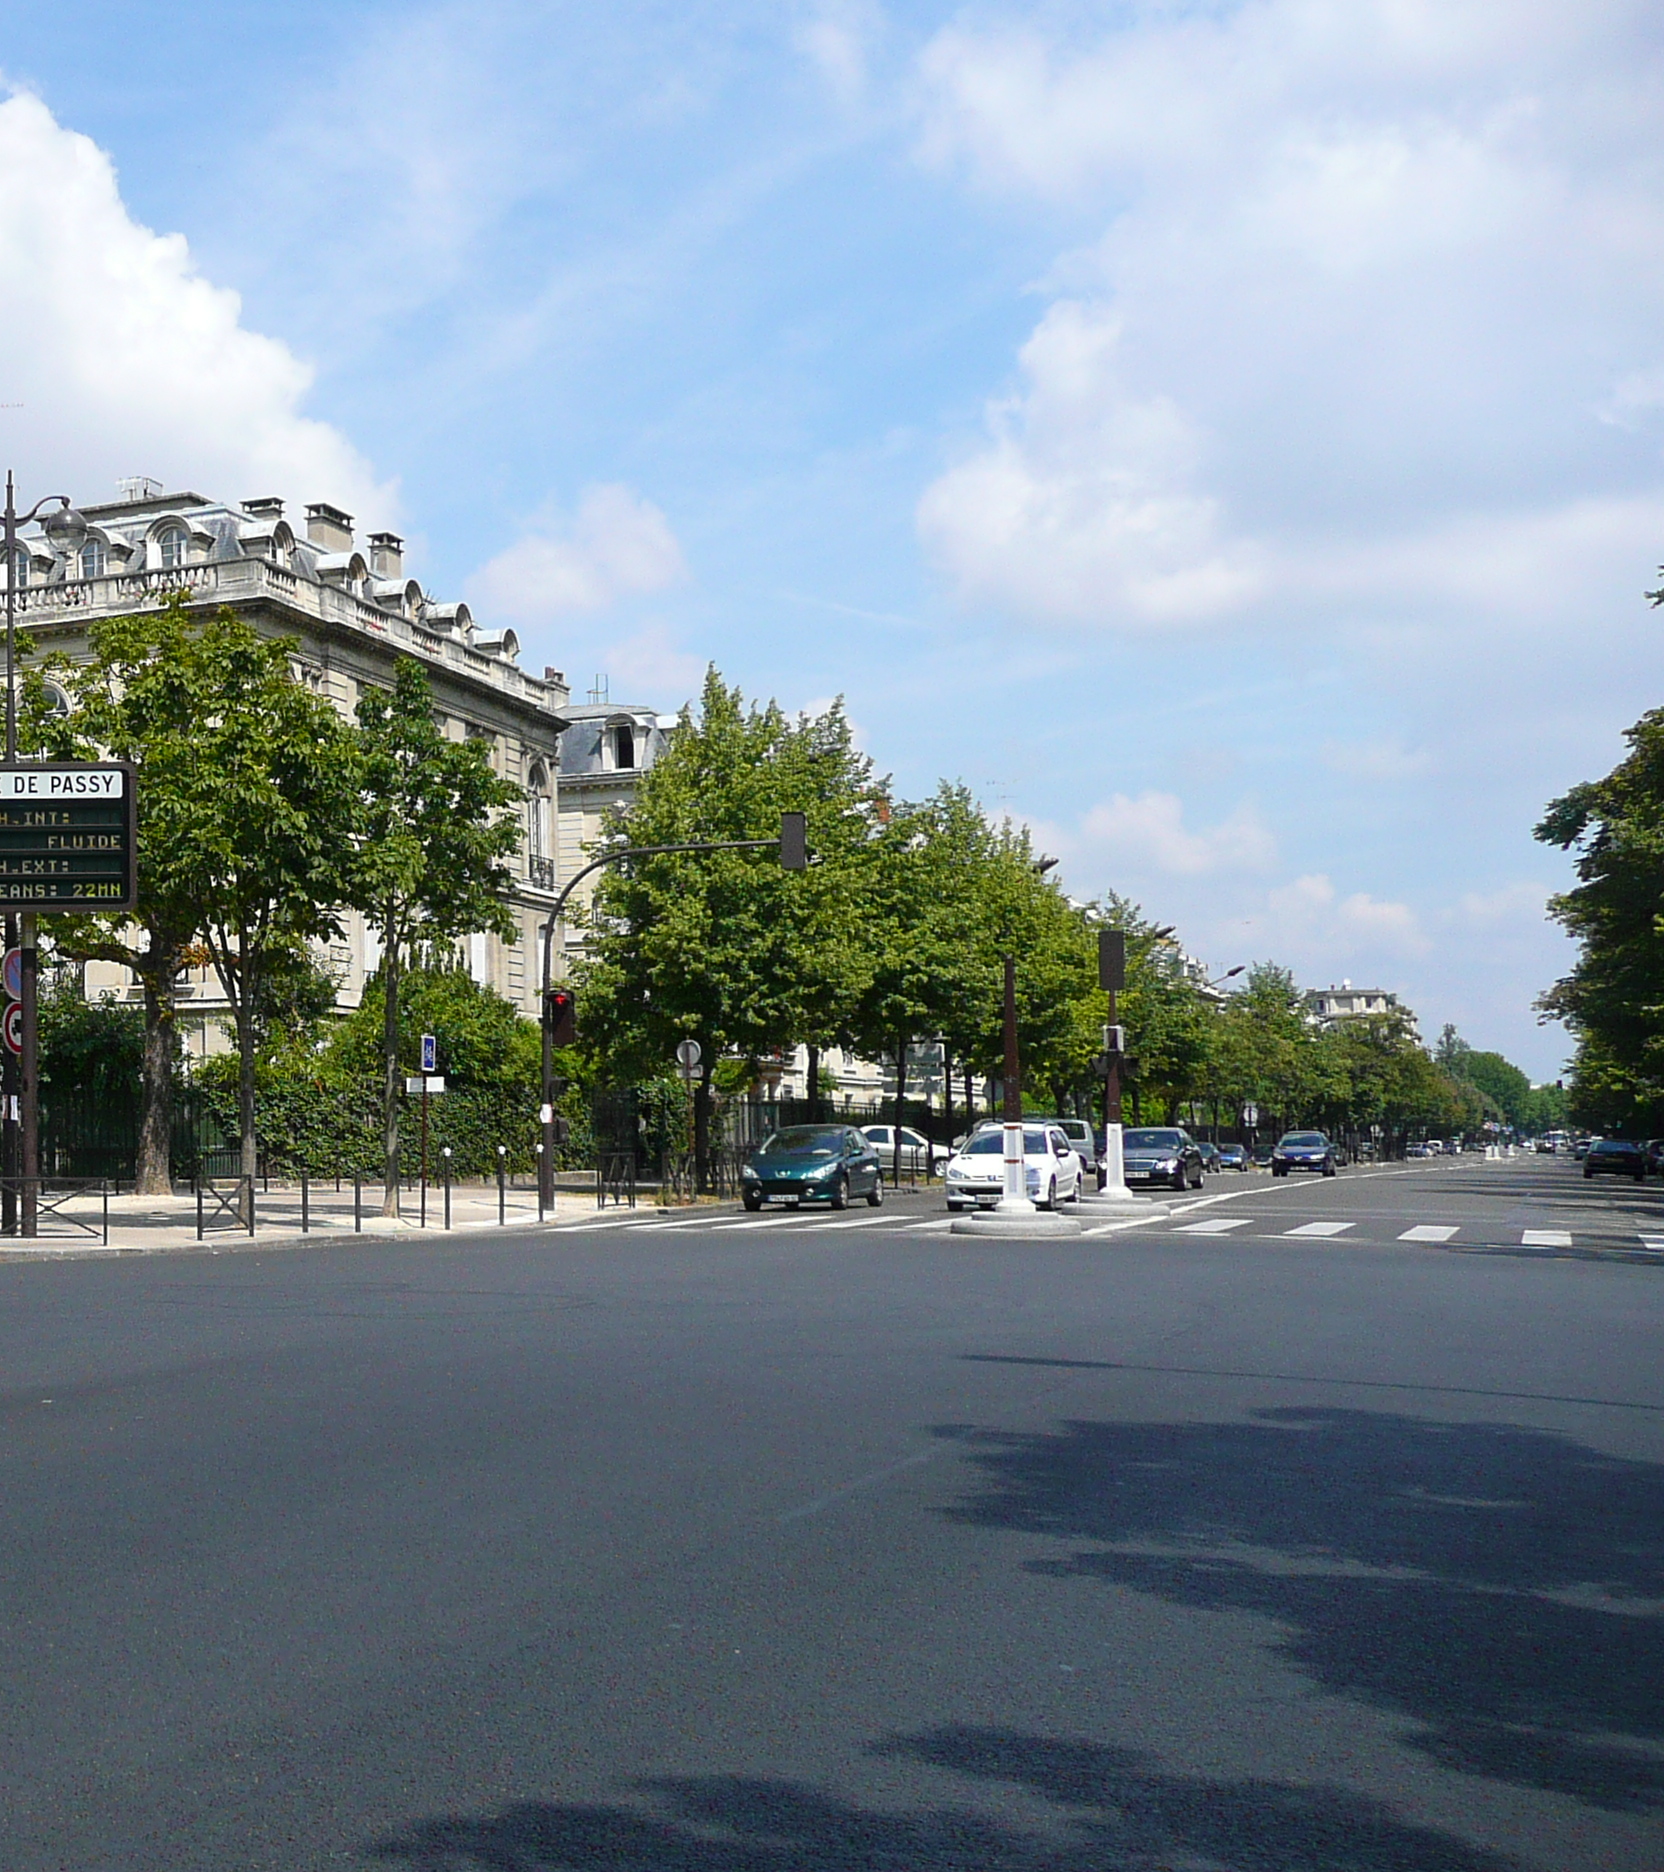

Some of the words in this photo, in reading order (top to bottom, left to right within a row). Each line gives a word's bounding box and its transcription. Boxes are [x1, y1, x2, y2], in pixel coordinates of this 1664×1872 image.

[14, 775, 39, 795] DE
[50, 774, 114, 794] PASSY
[47, 834, 122, 849] FLUIDE
[72, 883, 122, 897] 22MN
